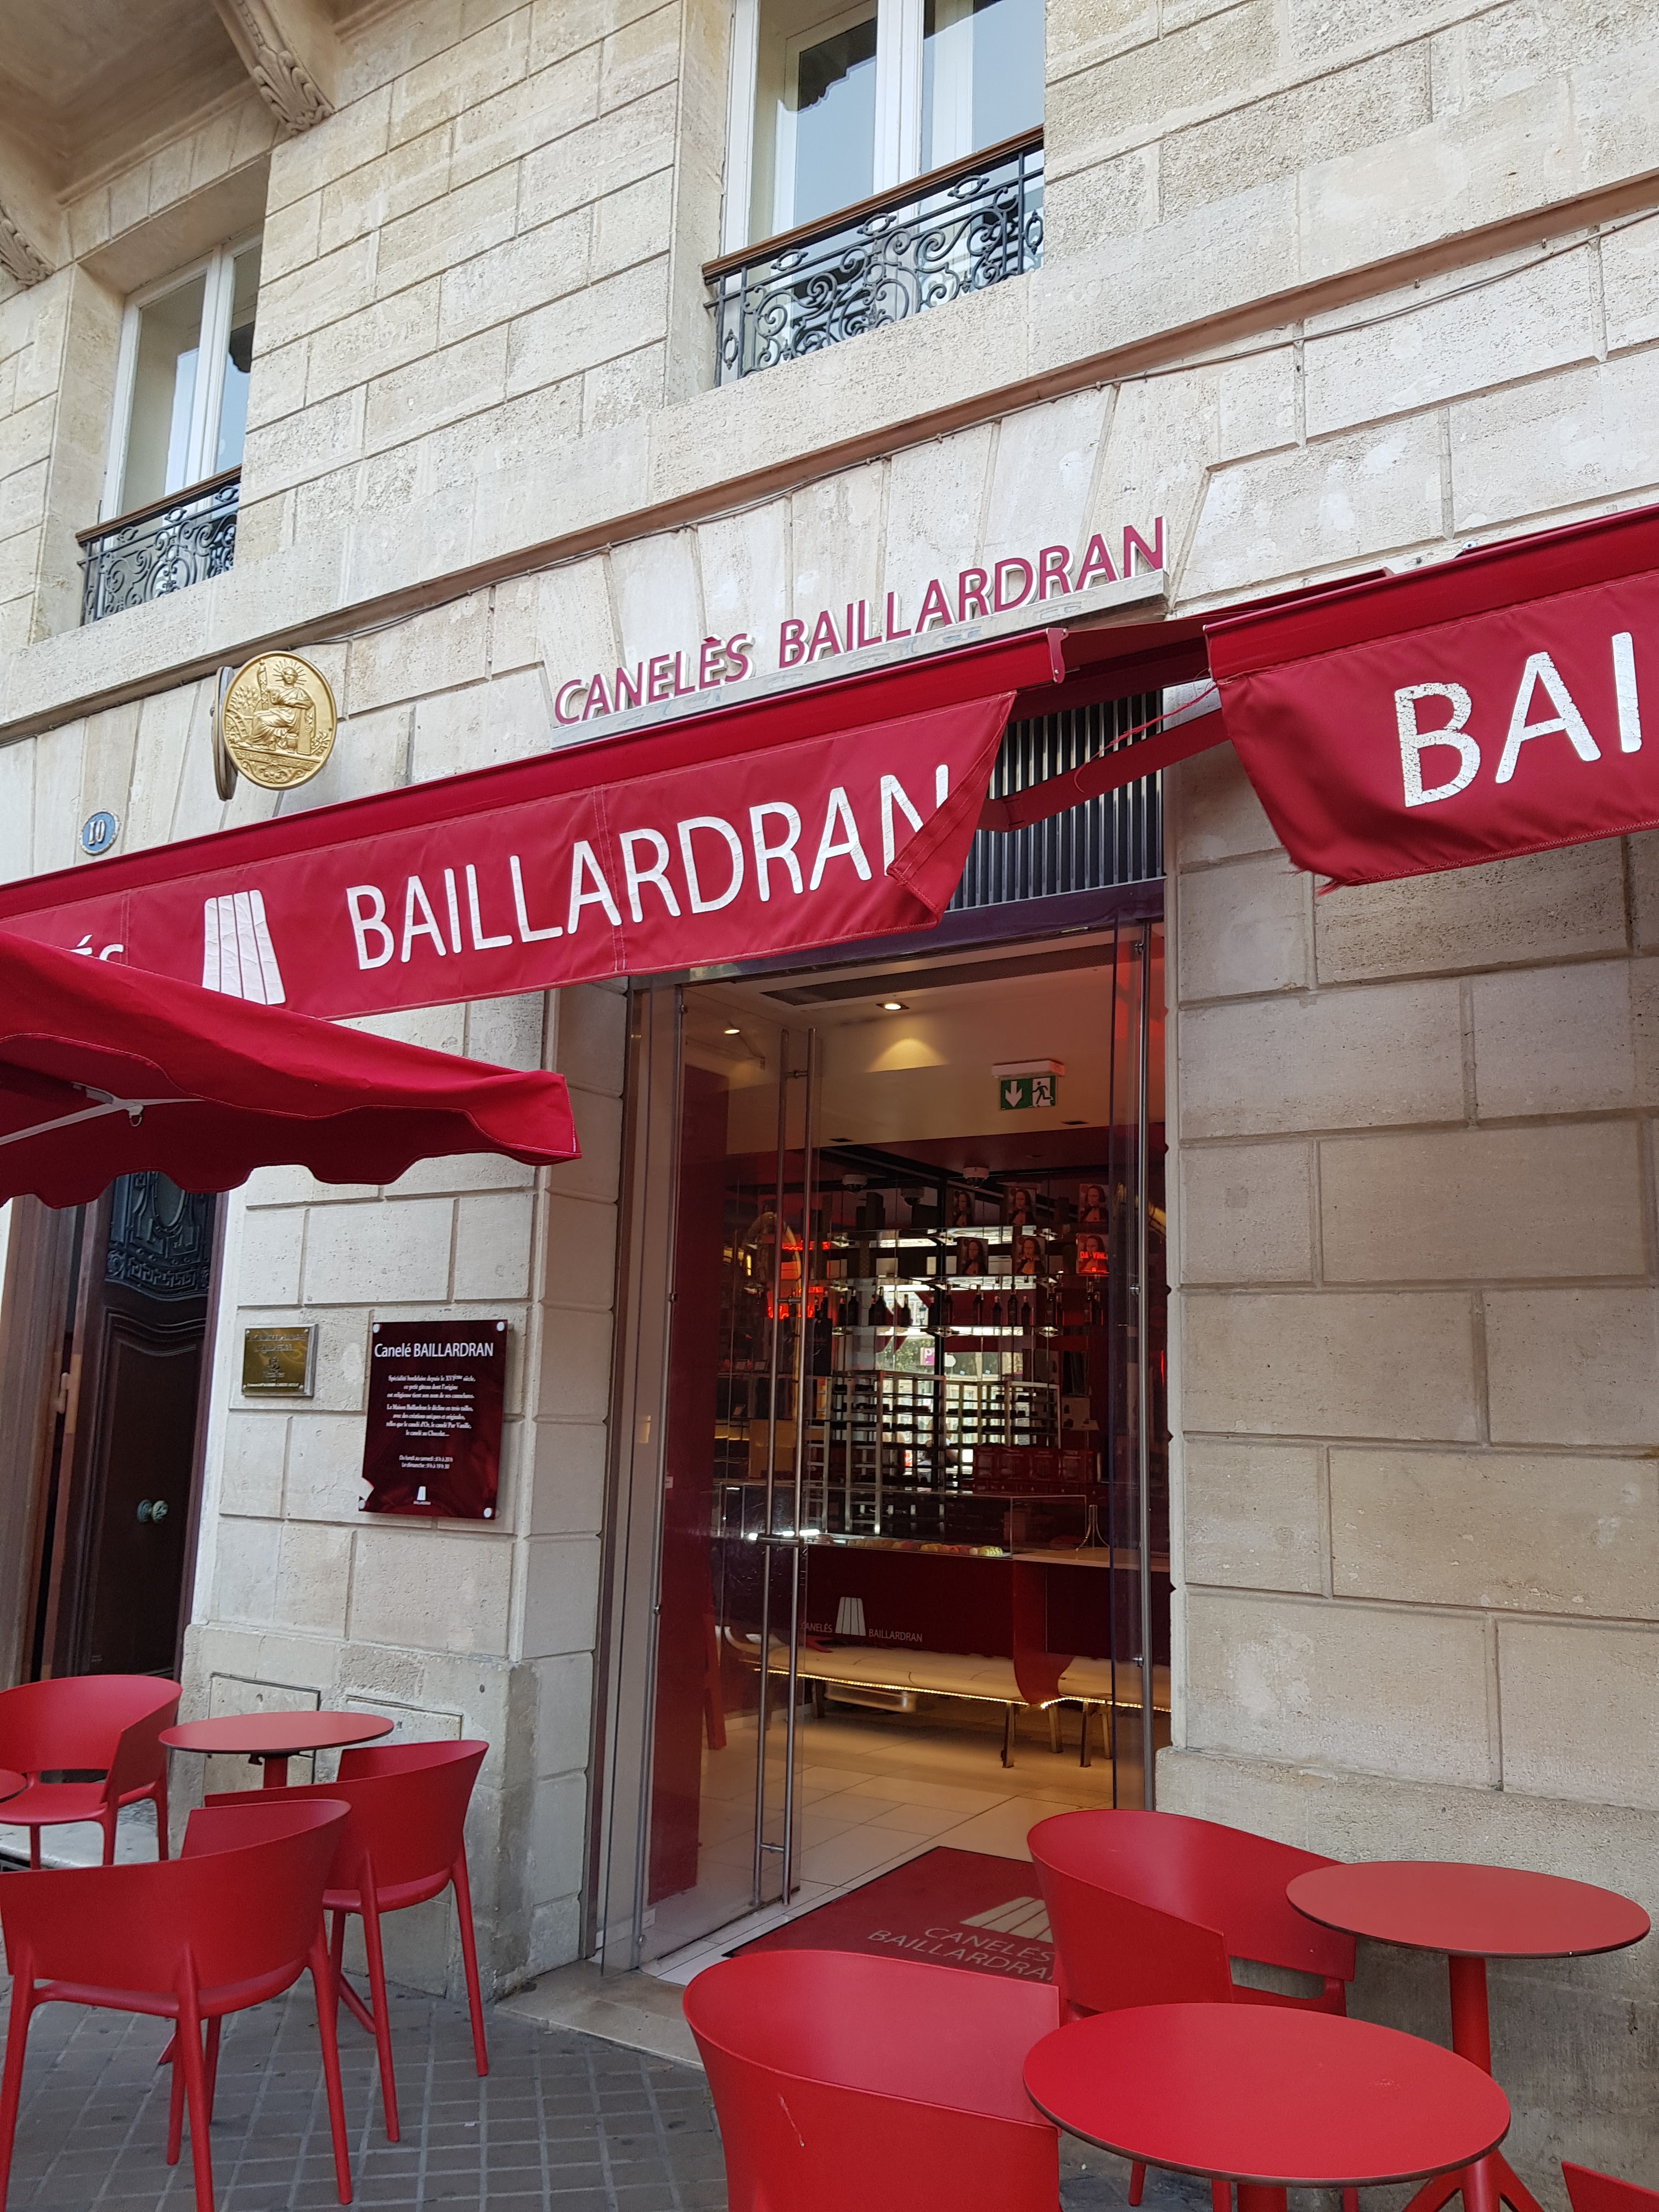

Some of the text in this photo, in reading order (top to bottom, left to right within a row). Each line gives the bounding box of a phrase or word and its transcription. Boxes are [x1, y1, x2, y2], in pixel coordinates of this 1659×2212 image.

[777, 516, 1167, 669] BAILLARDRAN
[1395, 631, 1643, 808] BAI
[88, 819, 105, 845] 10
[374, 1342, 494, 1357] Canelé BAILLARDRAN
[868, 1628, 923, 1643] BAILLARDRAN
[867, 1930, 1053, 1980] BAILLARDRA
[924, 1927, 1056, 1962] CANELÉS
